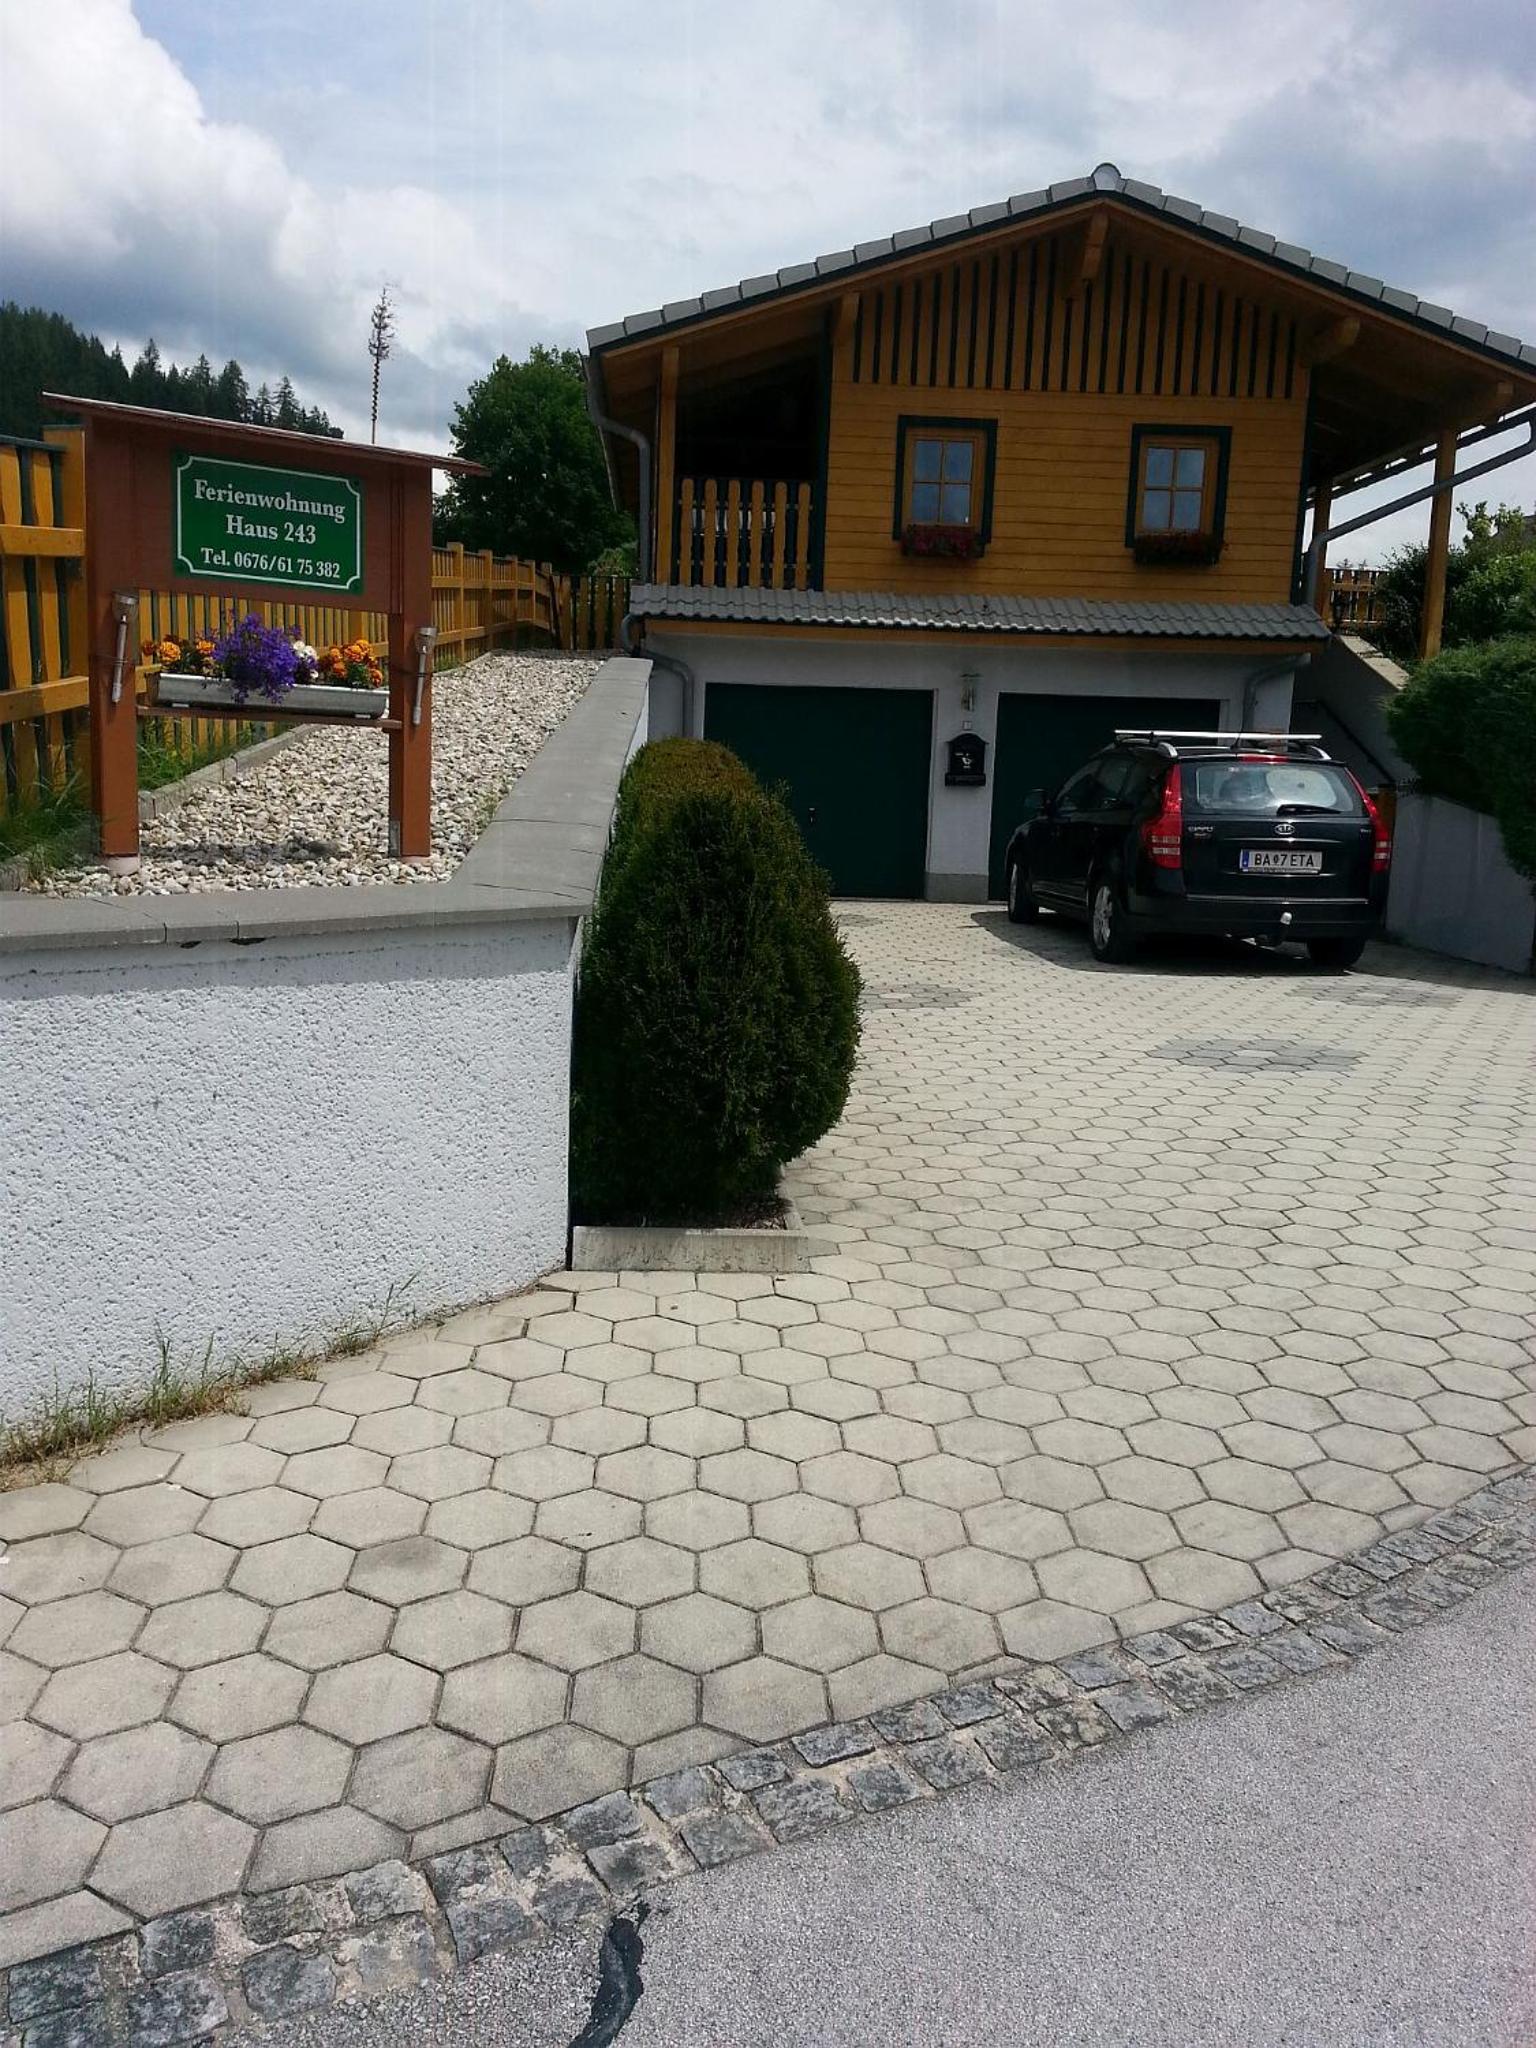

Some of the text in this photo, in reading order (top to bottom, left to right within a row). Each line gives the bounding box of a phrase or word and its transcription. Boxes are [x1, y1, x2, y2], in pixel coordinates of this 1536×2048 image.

[193, 478, 346, 524] Ferienwohnung
[225, 514, 317, 544] Haus 243
[200, 547, 341, 578] Tel. 0676/61 75 382
